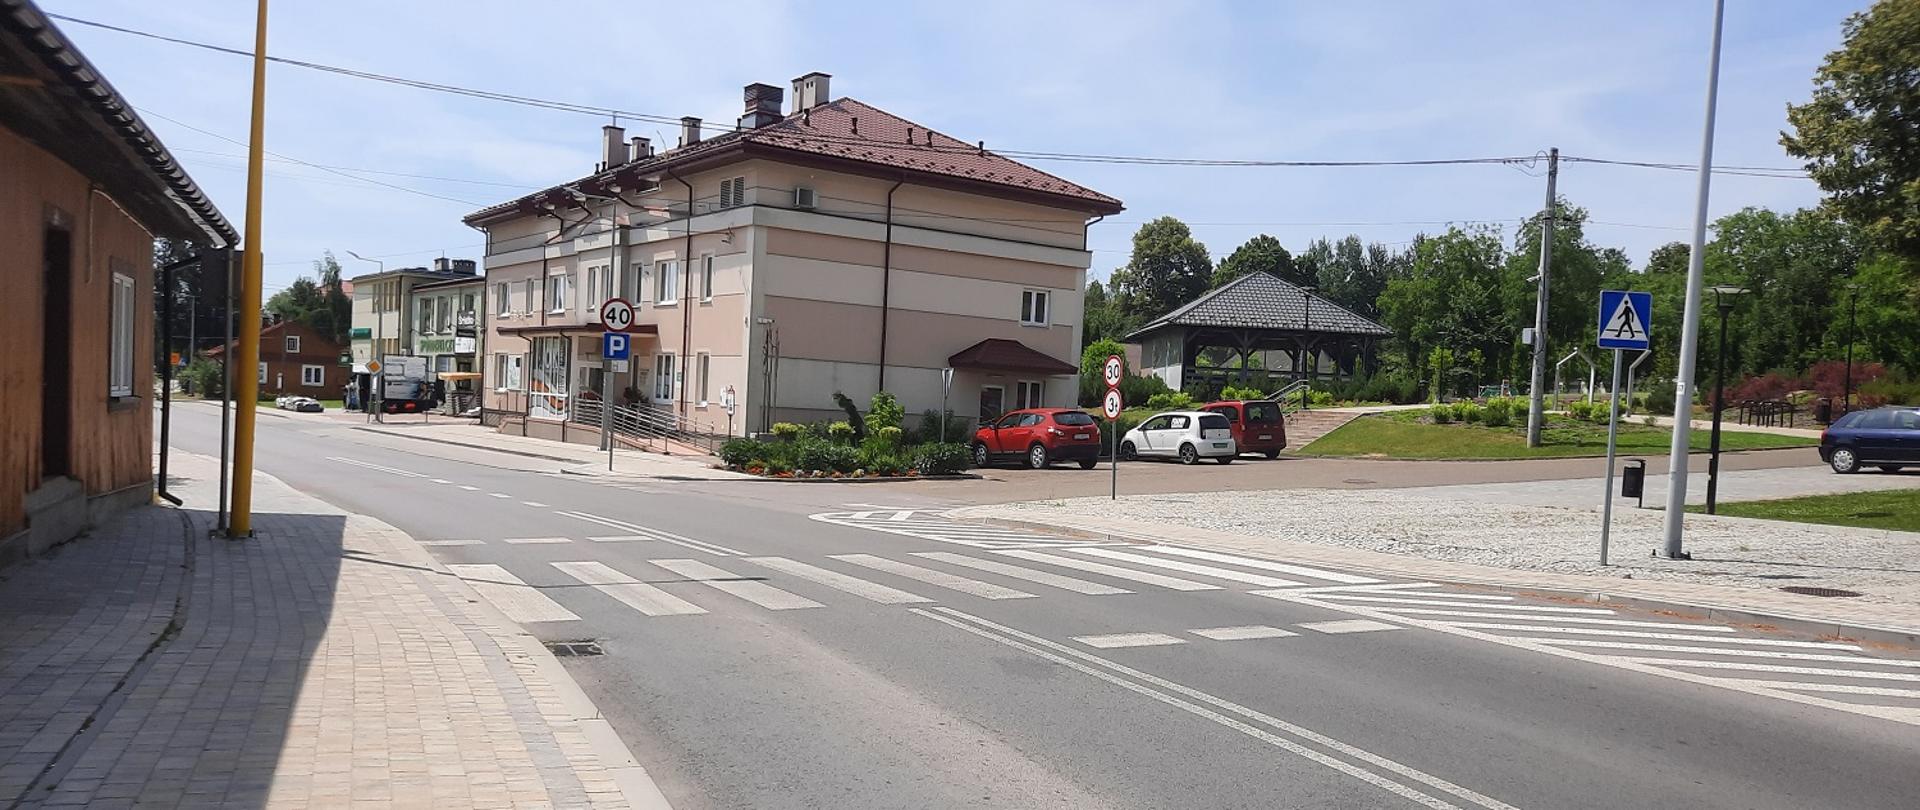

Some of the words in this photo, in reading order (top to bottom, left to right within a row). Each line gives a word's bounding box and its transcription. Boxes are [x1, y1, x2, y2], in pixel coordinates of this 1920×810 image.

[605, 307, 630, 324] 40
[609, 335, 625, 356] P
[1107, 364, 1119, 379] 30
